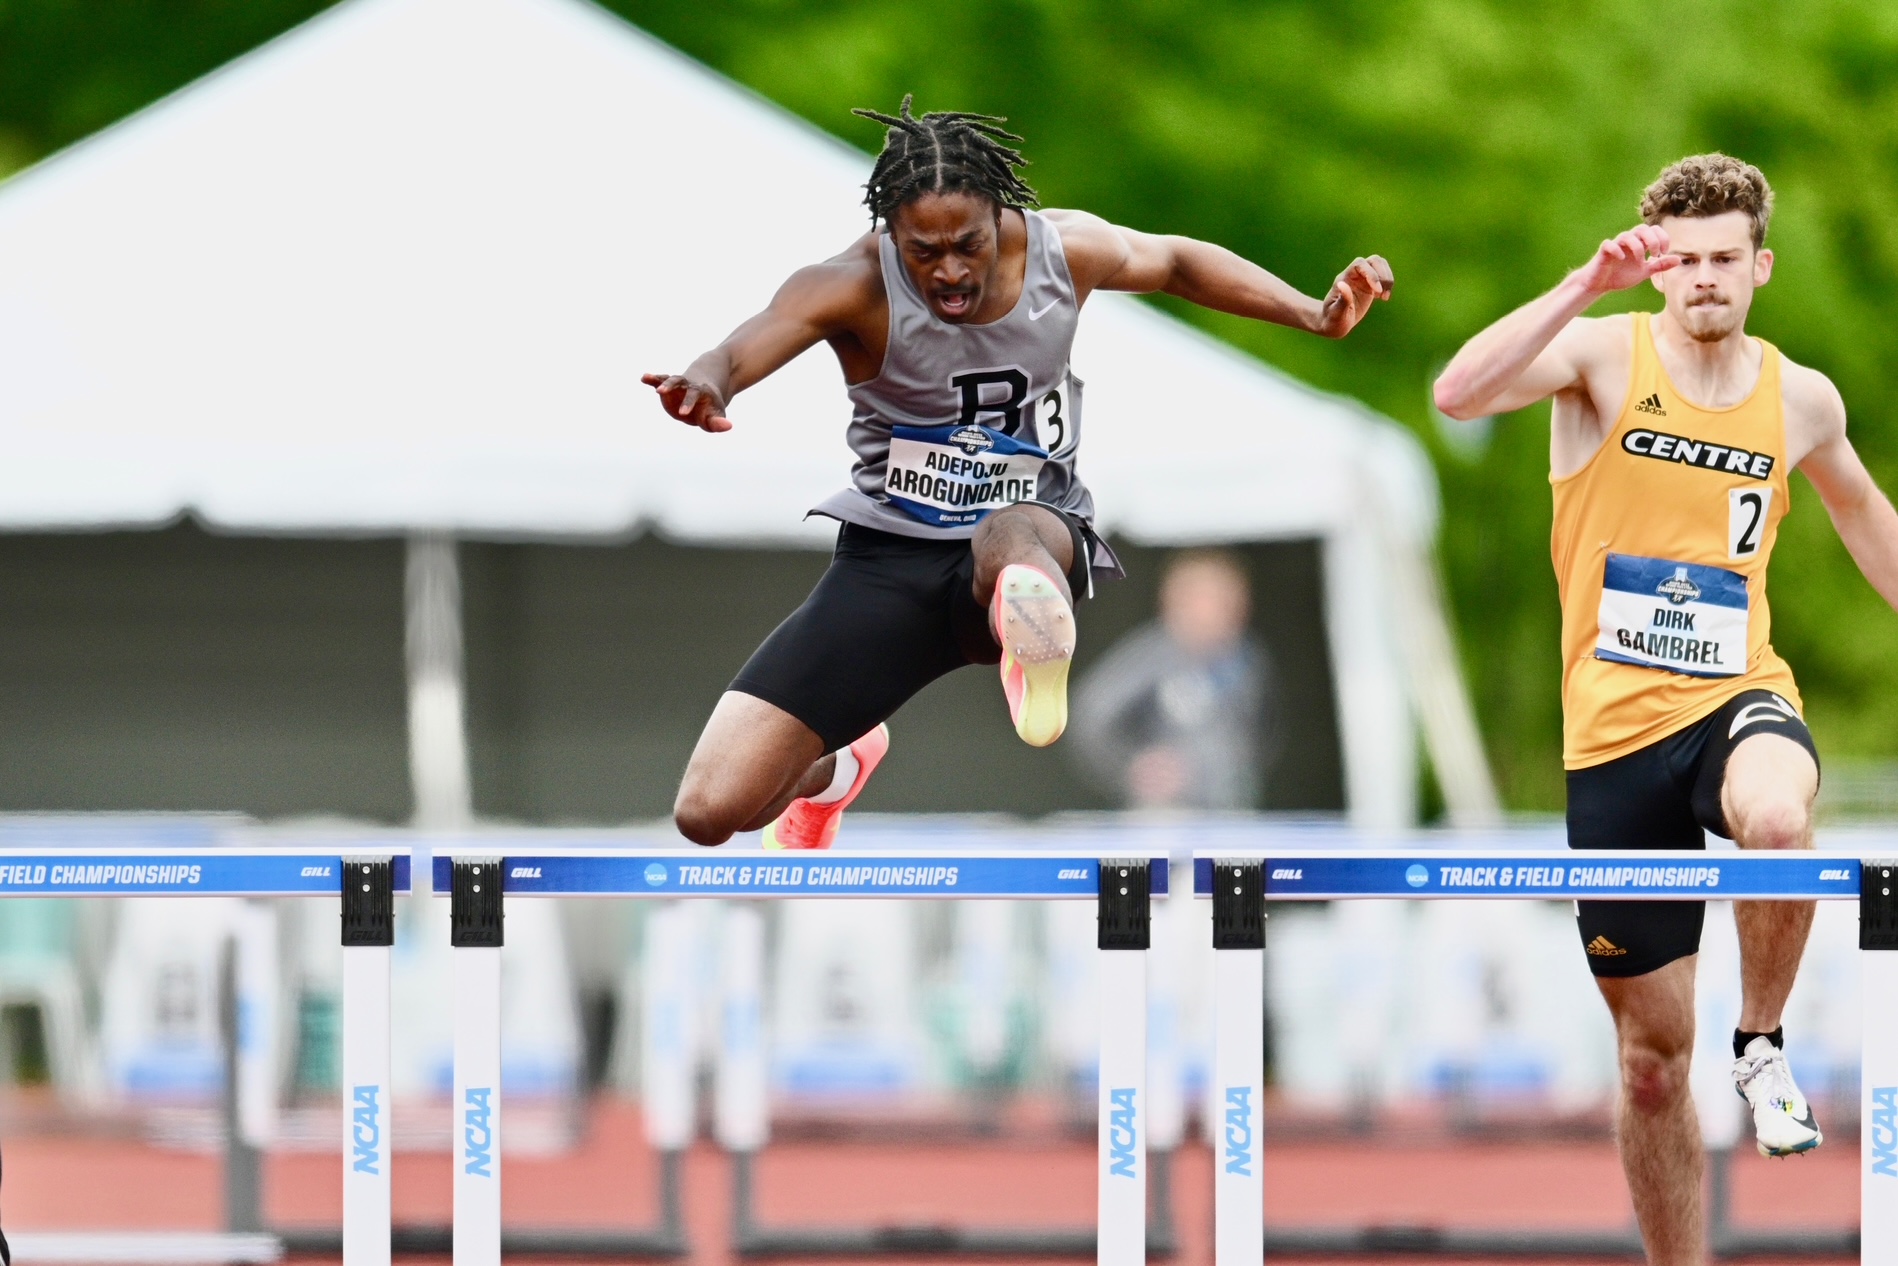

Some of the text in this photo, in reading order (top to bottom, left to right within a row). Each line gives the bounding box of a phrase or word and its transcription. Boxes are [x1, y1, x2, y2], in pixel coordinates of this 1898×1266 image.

[950, 365, 1032, 437] B
[1635, 404, 1667, 417] adidas
[1043, 389, 1064, 453] 3
[925, 451, 1008, 479] ADEPOJU
[1623, 429, 1774, 480] CENTRE
[888, 467, 1034, 507] AROGUNDADE
[1736, 492, 1762, 554] 2
[1653, 608, 1696, 631] DIRK
[1616, 628, 1724, 666] GAMBREL
[0, 865, 202, 884] FIELD CHAMPIONSHIPS
[301, 866, 331, 877] GILL
[510, 867, 542, 878] GILL
[646, 872, 668, 881] NCAA
[679, 866, 959, 886] TRACK & FIELD CHAMPIONSHIPS
[1057, 869, 1088, 880] GILL
[1272, 869, 1303, 880] GILL
[1408, 874, 1429, 882] NCAA
[1440, 867, 1720, 887] TRACK & FIELD CHAMPIONSHIPS
[1819, 869, 1850, 880] GILL
[1587, 948, 1627, 956] adidas
[353, 1085, 379, 1175] NCAA
[465, 1087, 491, 1178] NCAA
[1110, 1088, 1136, 1179] NCAA
[1225, 1086, 1251, 1177] NCAA
[1872, 1087, 1898, 1178] NCAA
